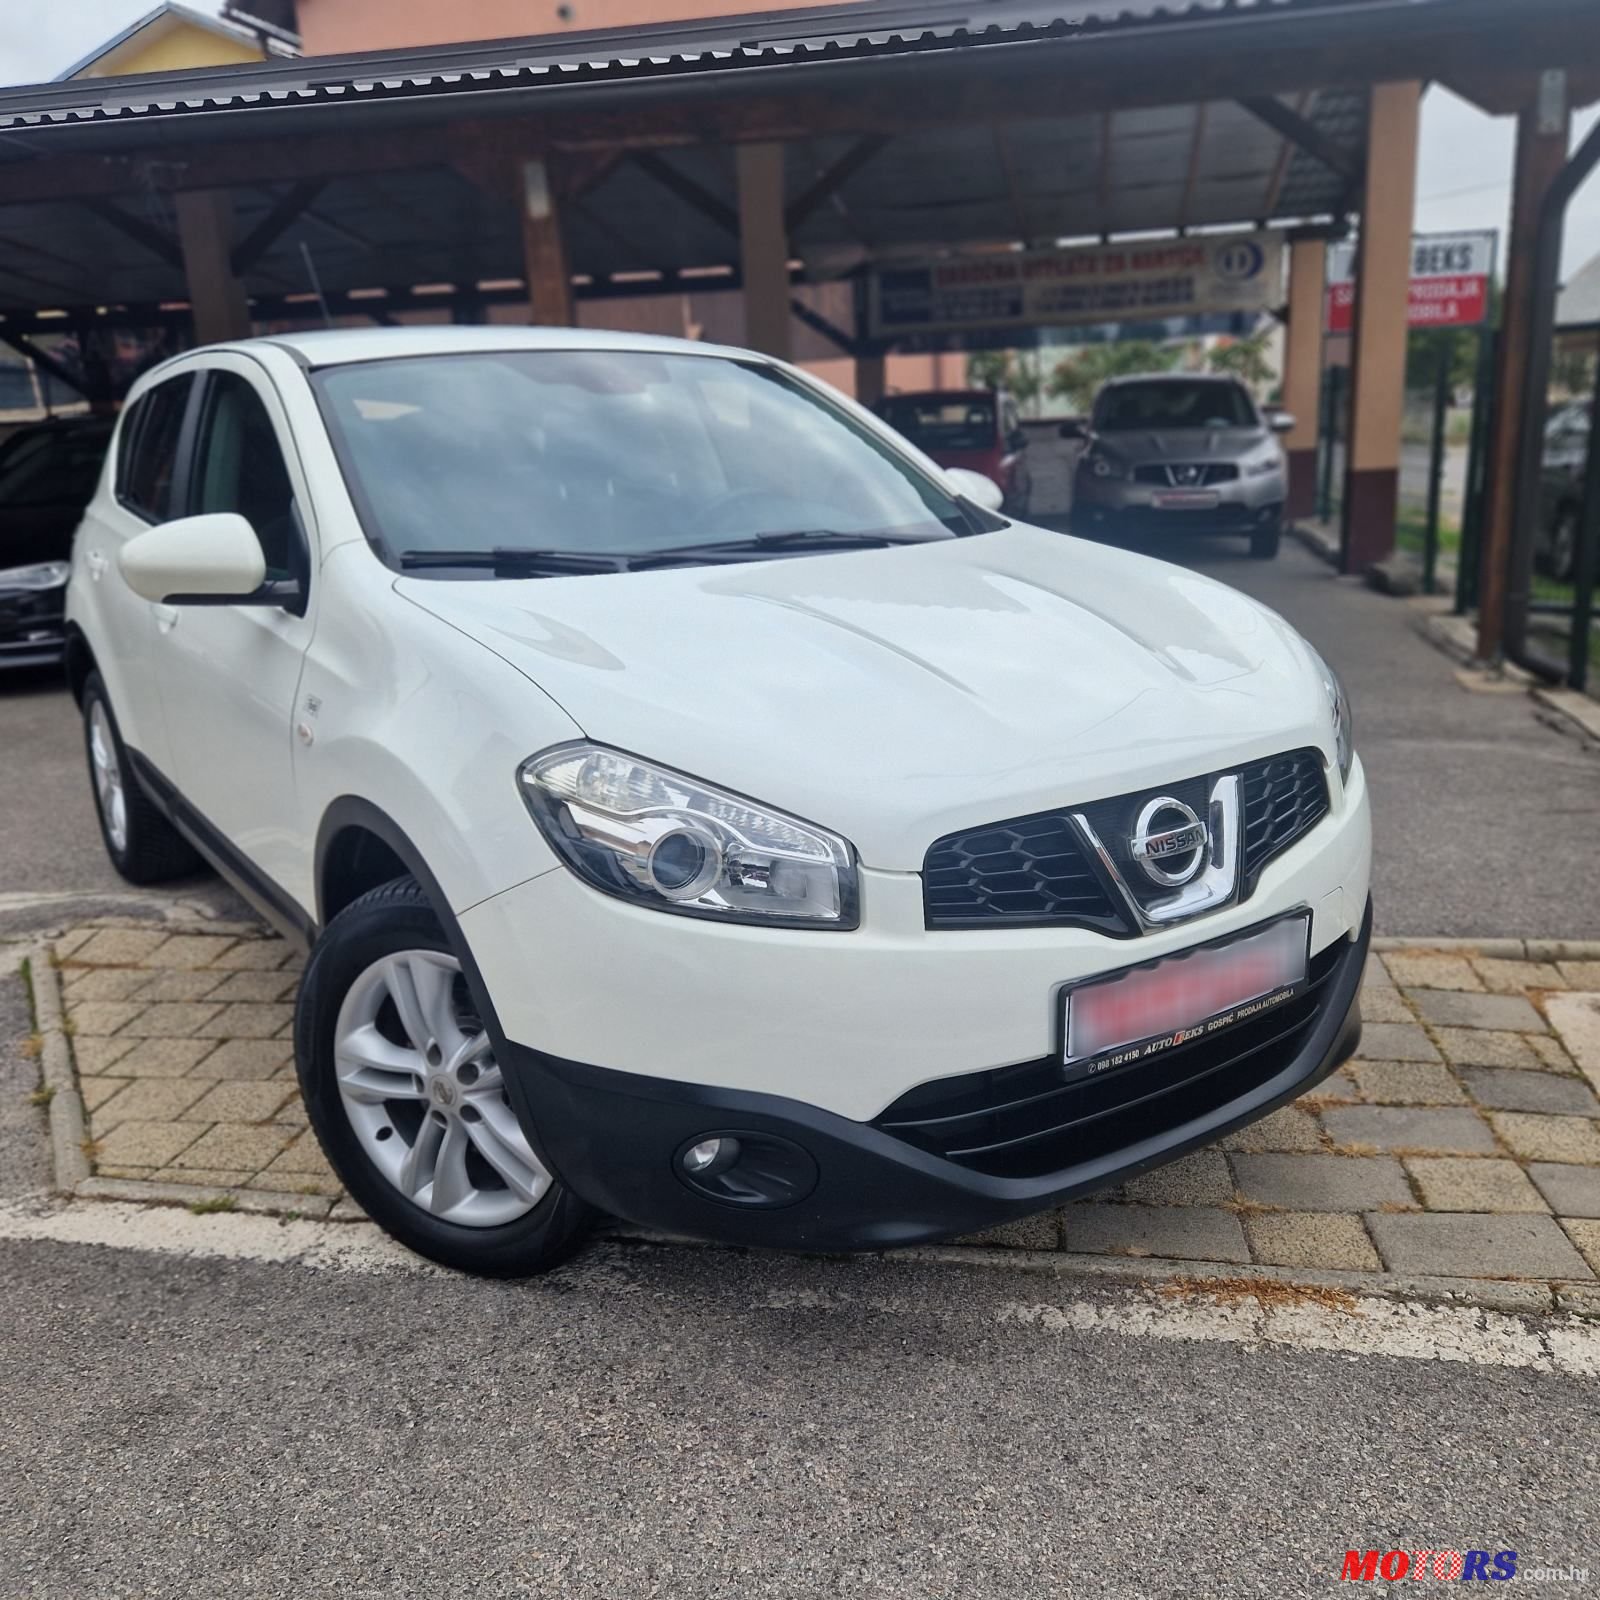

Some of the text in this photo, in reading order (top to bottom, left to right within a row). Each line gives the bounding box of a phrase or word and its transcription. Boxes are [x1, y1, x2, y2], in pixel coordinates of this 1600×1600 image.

[1414, 243, 1473, 274] BEKS
[1144, 829, 1204, 856] NISSAN
[1111, 1055, 1123, 1067] 182
[1144, 1037, 1173, 1055] AUTO
[1237, 1002, 1262, 1020] PRODAJA
[1261, 988, 1294, 1009] AUTOMOBILA
